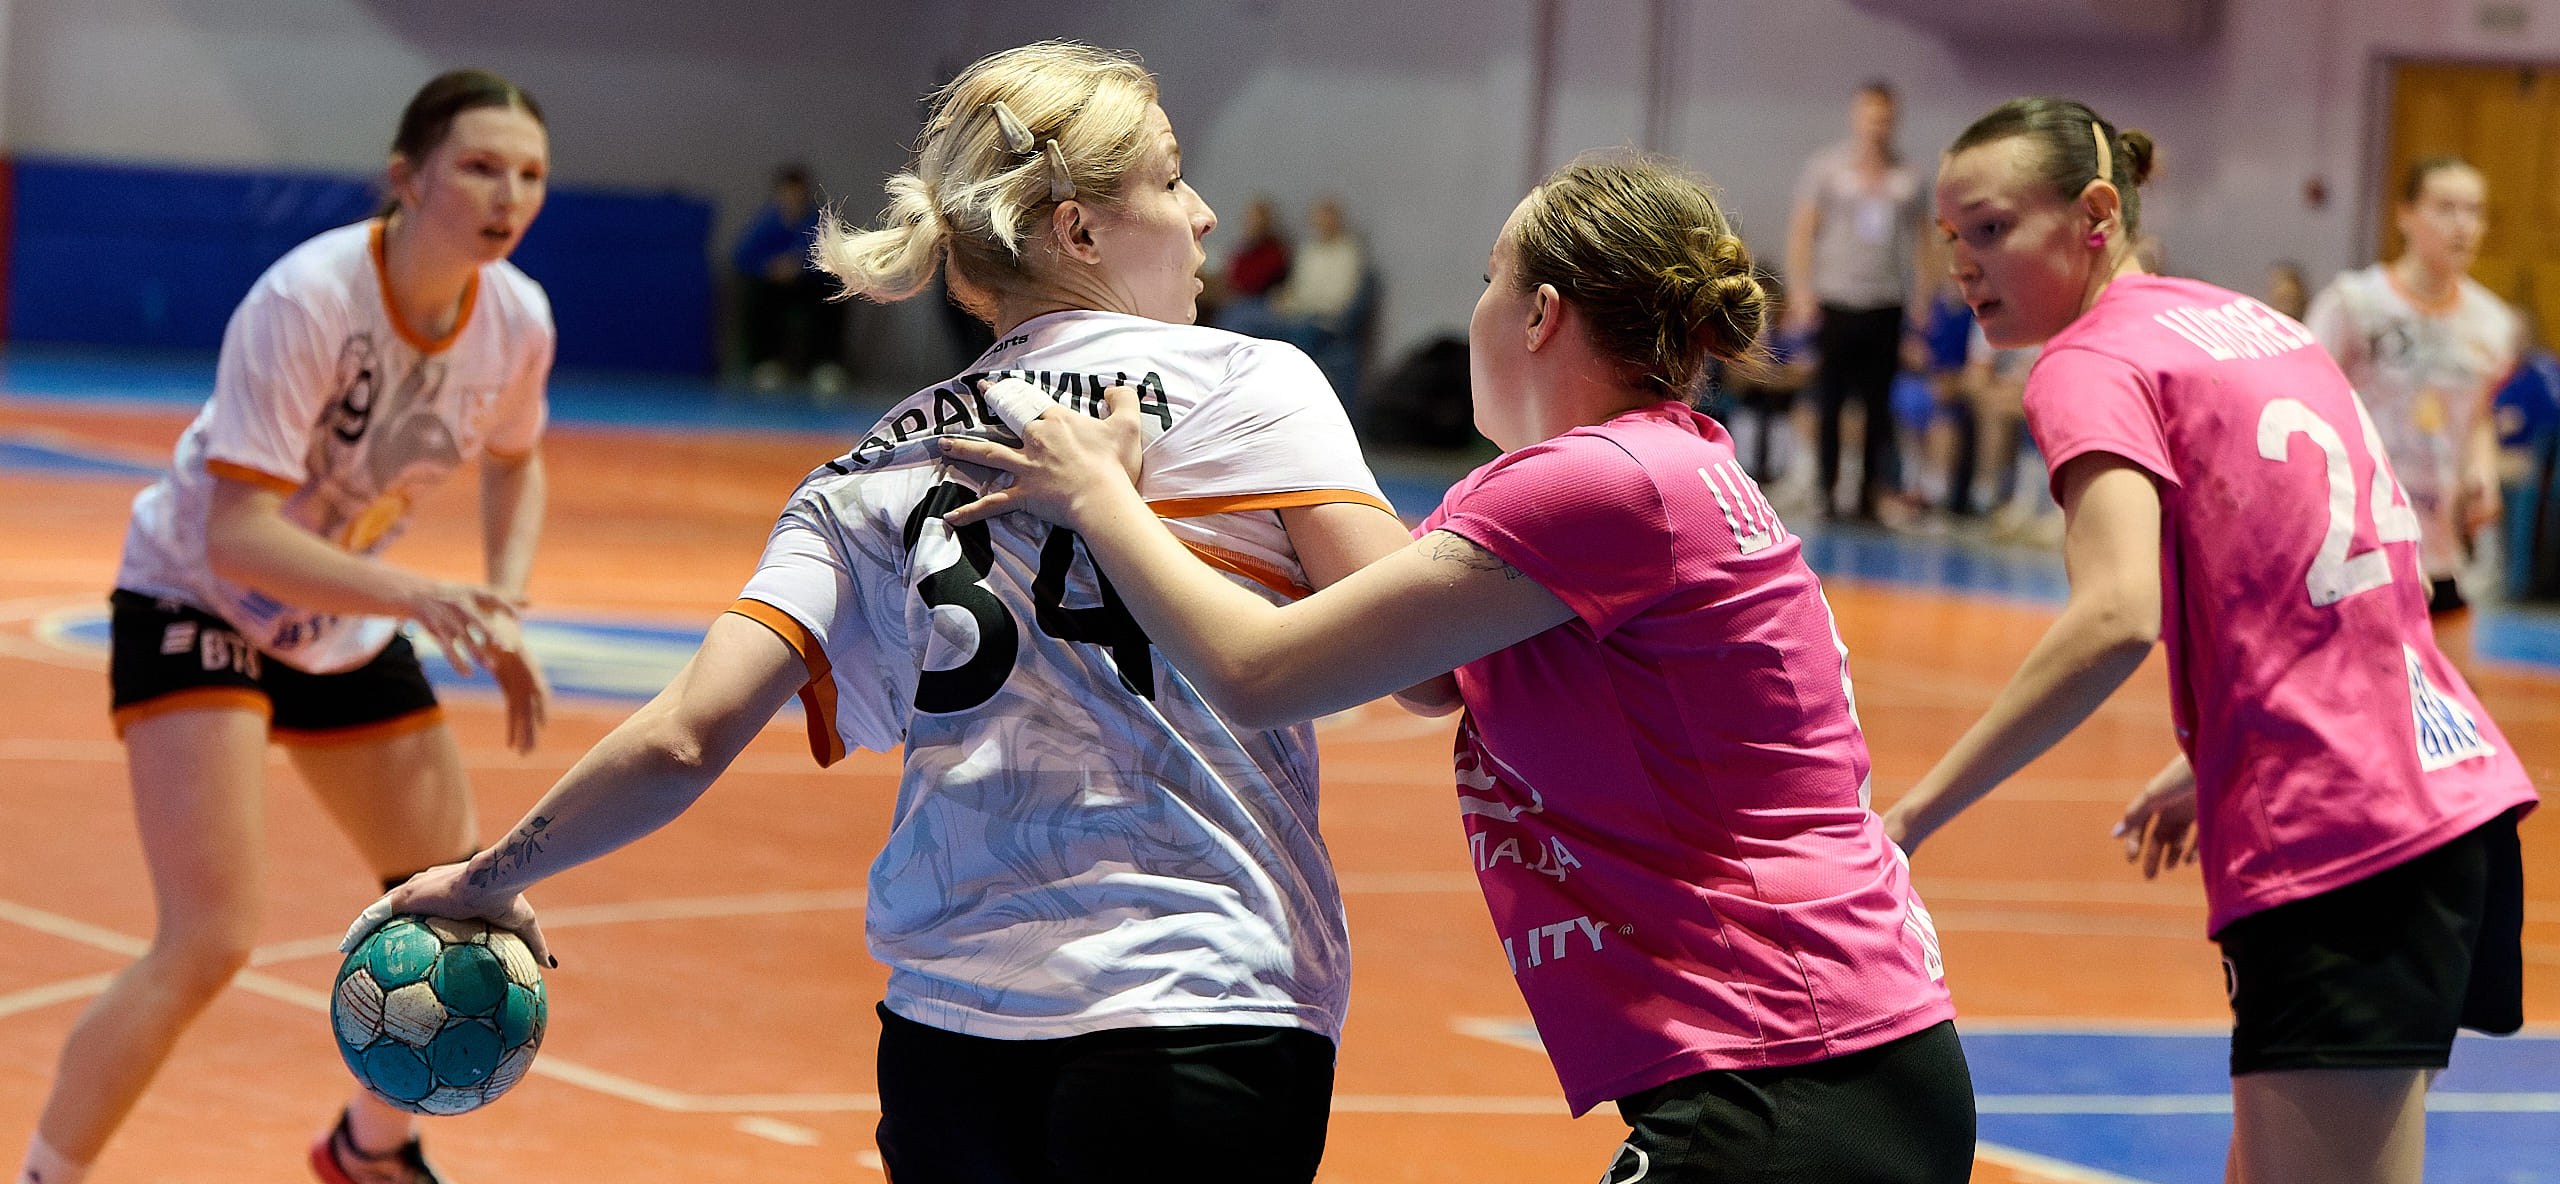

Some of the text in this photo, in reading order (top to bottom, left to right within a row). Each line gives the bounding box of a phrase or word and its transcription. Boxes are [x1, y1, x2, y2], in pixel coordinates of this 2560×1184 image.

[981, 333, 1030, 361] orts
[903, 480, 1156, 714] 34
[2256, 387, 2422, 607] 24
